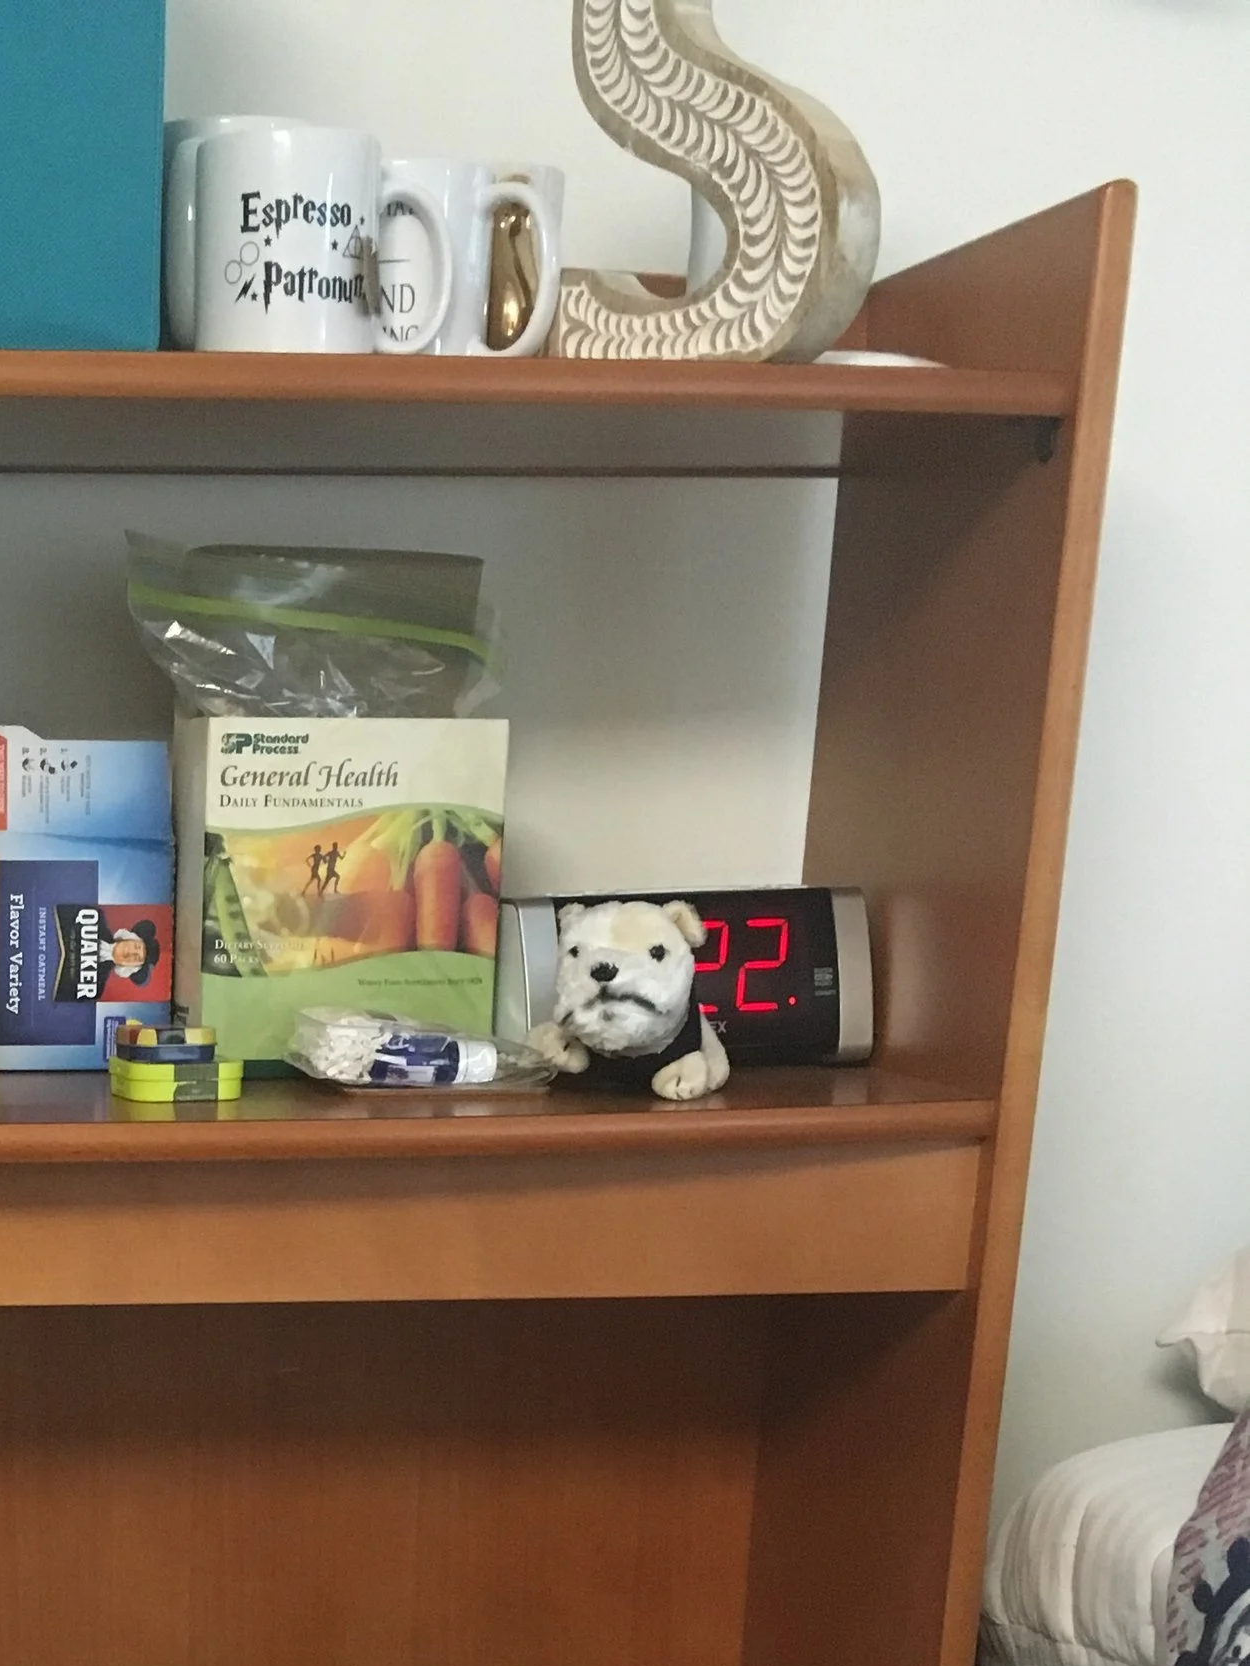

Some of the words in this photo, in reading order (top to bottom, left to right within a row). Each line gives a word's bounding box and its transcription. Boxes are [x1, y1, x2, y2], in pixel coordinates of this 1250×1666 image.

[240, 191, 351, 239] Espresso
[252, 744, 300, 754] Process
[253, 733, 309, 744] Standard
[220, 760, 317, 787] General
[316, 758, 399, 792] Health
[219, 794, 259, 807] DAILY
[264, 794, 364, 807] FUNDAMENTALS
[9, 894, 24, 950] Flavor
[38, 907, 47, 952] INSTANT
[75, 908, 99, 1000] QUAKER
[214, 954, 227, 964] 60
[6, 952, 24, 1015] Variety
[37, 954, 47, 1001] OATMEAL
